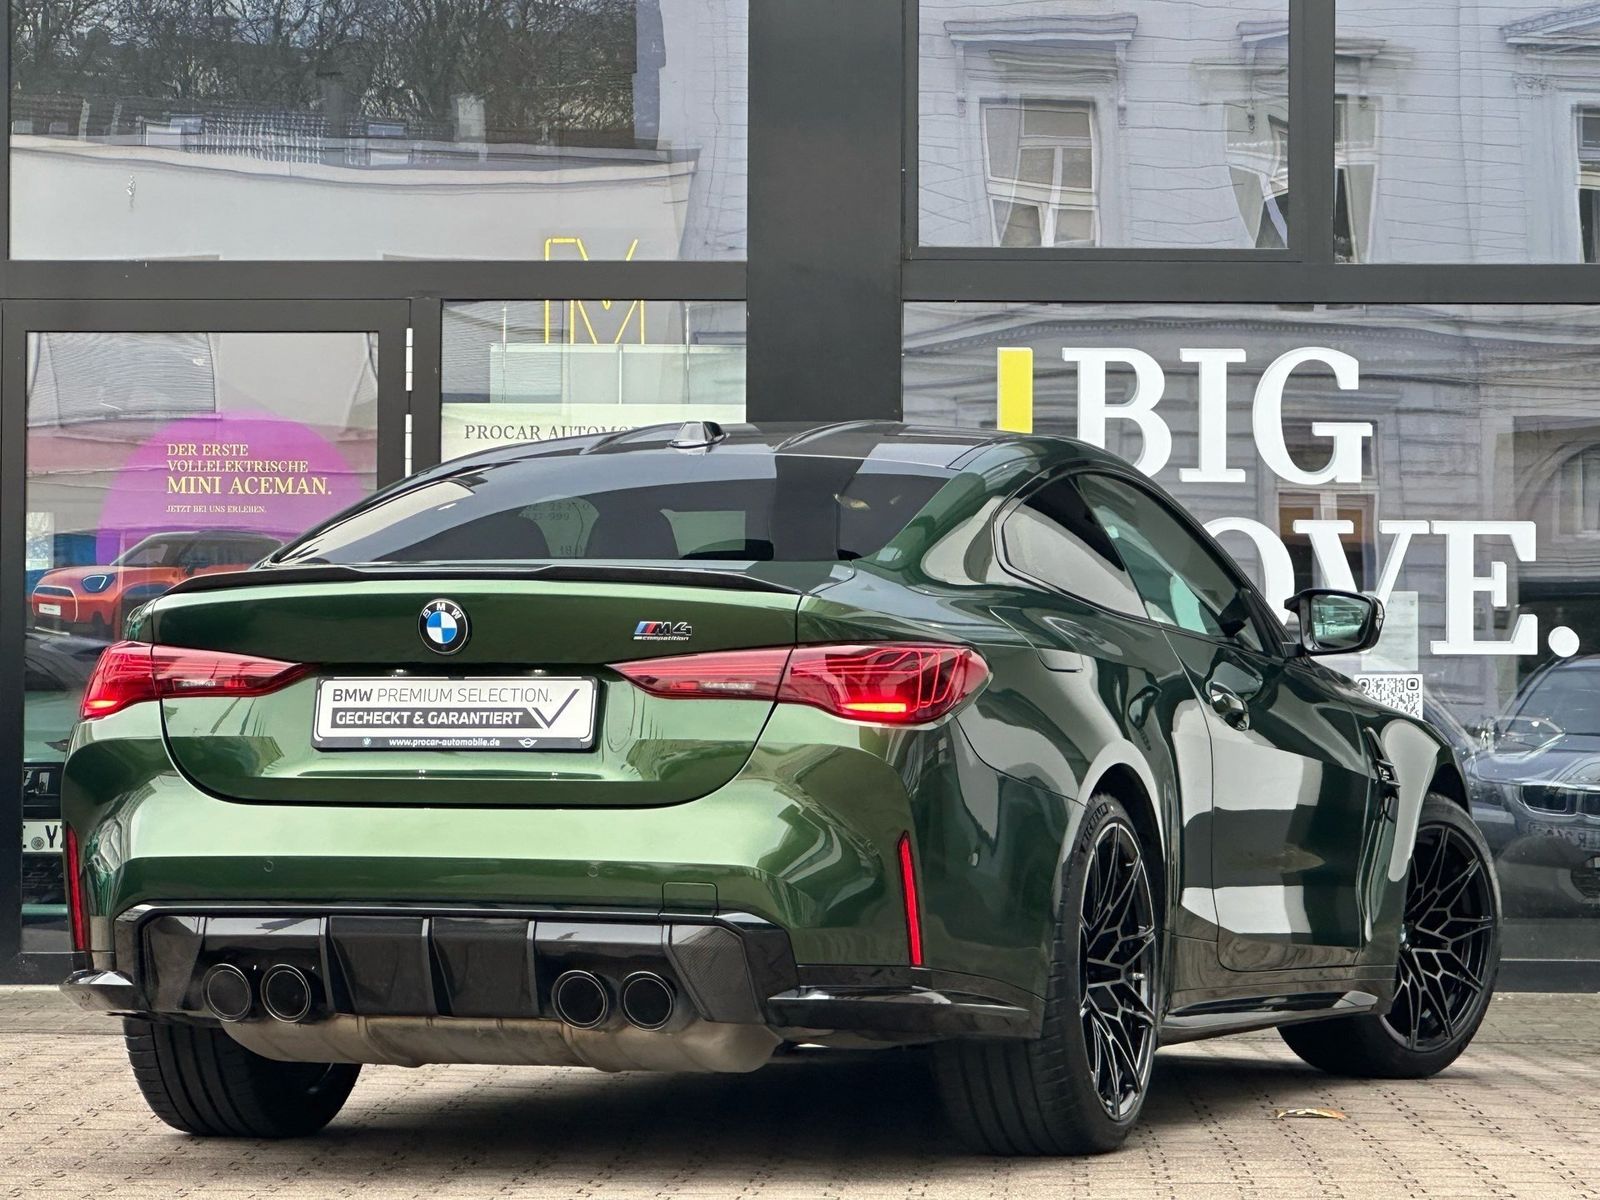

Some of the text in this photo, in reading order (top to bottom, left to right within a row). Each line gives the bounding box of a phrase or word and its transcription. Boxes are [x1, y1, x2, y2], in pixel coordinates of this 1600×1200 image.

[1062, 346, 1373, 485] BIG
[465, 425, 541, 440] PROCAR
[166, 443, 249, 456] DER ERSTE
[166, 460, 309, 473] VOLLELEKTRISCHE
[166, 476, 332, 495] MINI ACEMAN.
[166, 505, 192, 513] JETZT
[193, 505, 207, 513] BEI
[209, 505, 226, 513] UNS
[422, 602, 463, 620] BMW
[332, 688, 552, 703] BMW PREMIUM SELECTION.
[336, 711, 523, 725] GECHECKT & GARANTIERT
[388, 738, 500, 748] www.procar-automobile.de
